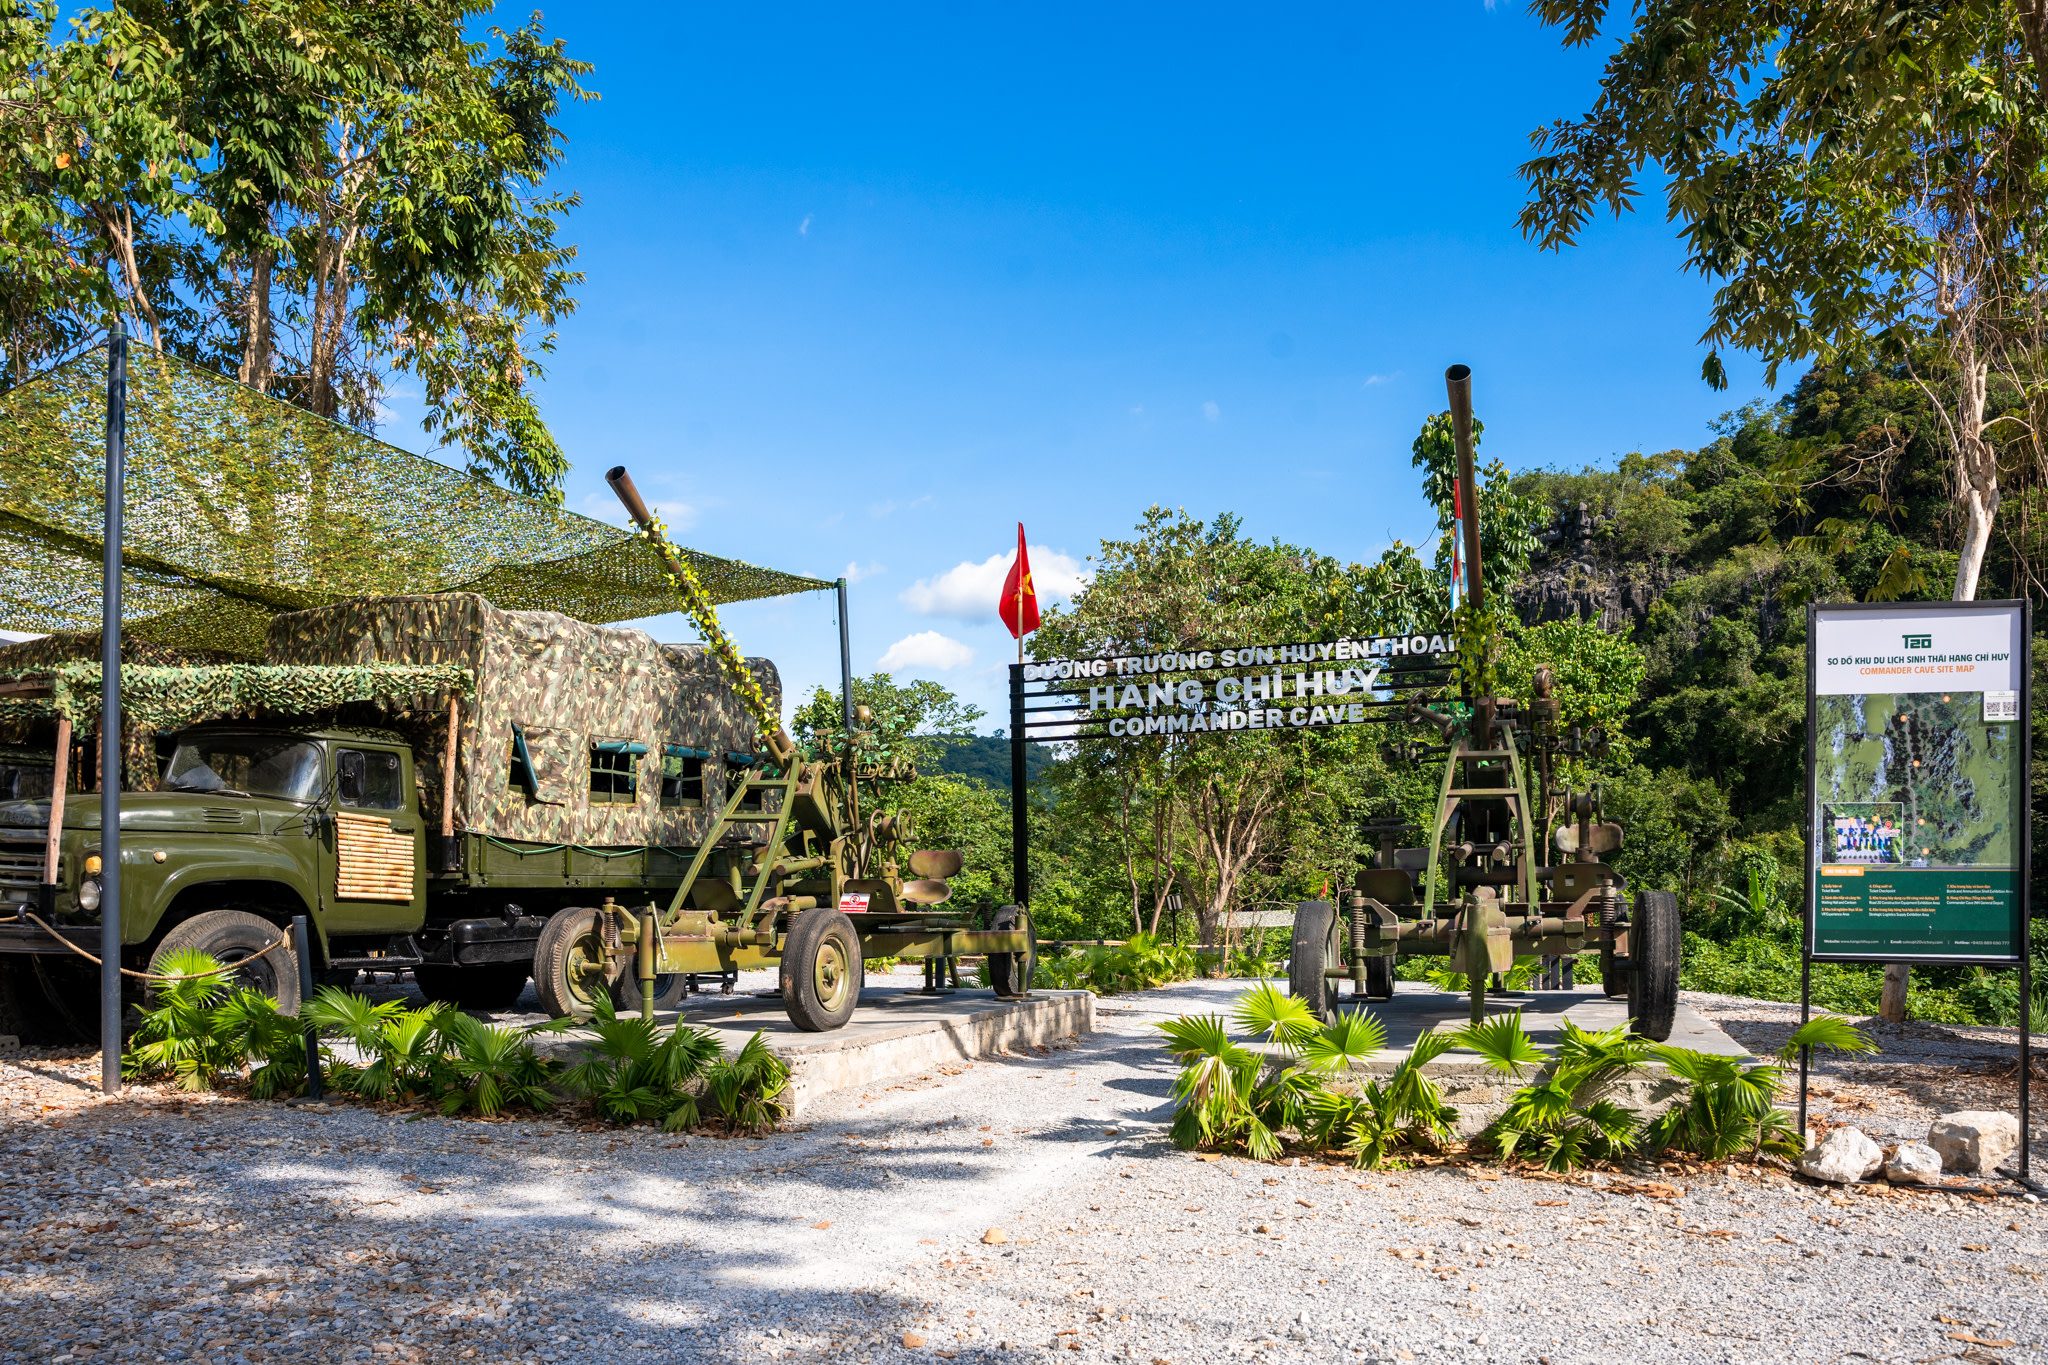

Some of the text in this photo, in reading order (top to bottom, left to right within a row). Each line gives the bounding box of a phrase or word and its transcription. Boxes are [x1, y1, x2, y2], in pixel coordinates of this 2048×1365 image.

[1902, 634, 1931, 649] T20
[1113, 649, 1214, 675] TRƯỜNG
[1221, 646, 1274, 667] SƠN
[1281, 636, 1369, 663] HUYỀN
[1854, 656, 1871, 664] KHU
[1873, 656, 1885, 664] DU
[1887, 656, 1905, 665] LỊCH
[1907, 655, 1926, 663] SINH
[1949, 654, 1973, 662] HANG
[1991, 653, 2009, 661] HUY
[1860, 664, 1975, 675] COMMANDER CAVE SITE MAP
[1090, 667, 1380, 711] HANG CHỈ HUY
[1109, 704, 1365, 737] COMMANDER CAVE
